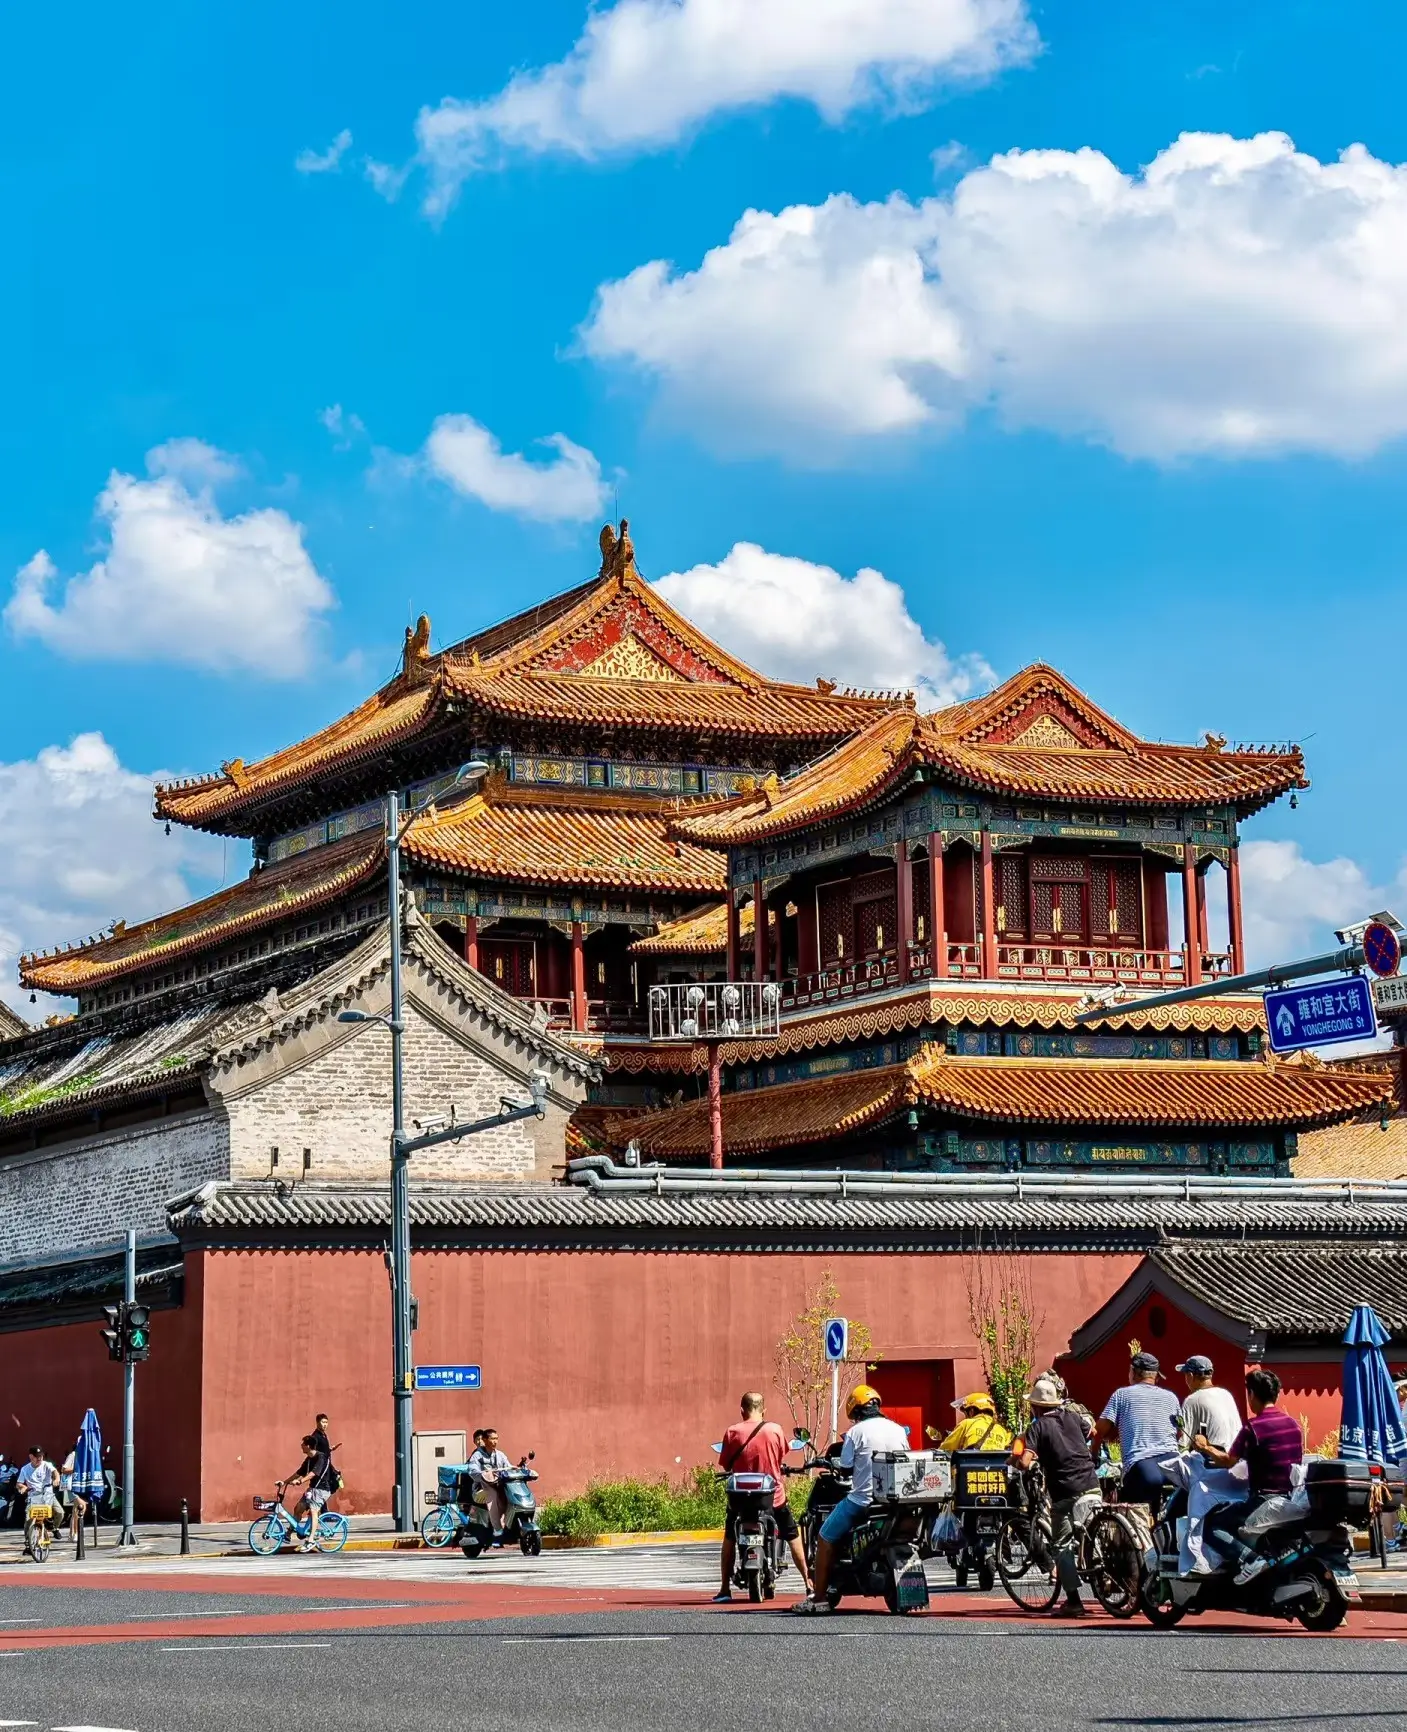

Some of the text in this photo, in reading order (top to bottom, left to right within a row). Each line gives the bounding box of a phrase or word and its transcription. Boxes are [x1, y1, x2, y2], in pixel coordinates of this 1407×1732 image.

[1297, 988, 1361, 1020] 雍和宫大街
[1281, 1013, 1288, 1024] 南
[1284, 1026, 1289, 1034] S
[1302, 1016, 1364, 1036] YONGHEGONG St
[430, 1371, 454, 1379] 公共厕所
